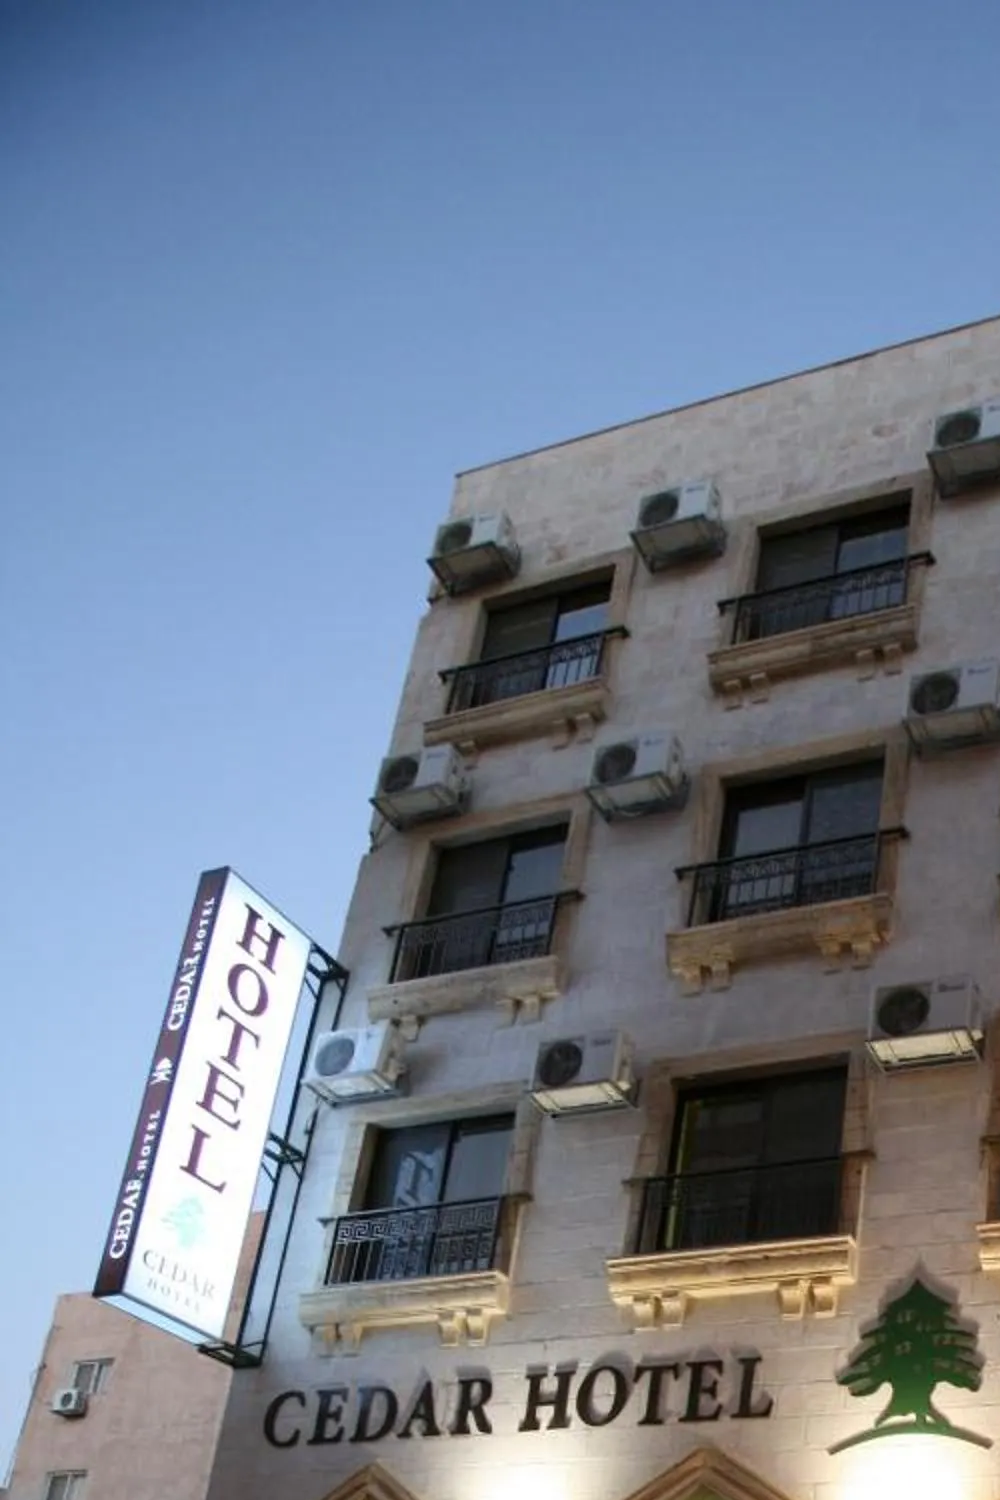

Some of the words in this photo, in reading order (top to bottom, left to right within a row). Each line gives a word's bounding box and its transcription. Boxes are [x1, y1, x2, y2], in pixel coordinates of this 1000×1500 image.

[167, 953, 201, 1032] CEDAR
[179, 902, 286, 1194] HOTEL
[136, 1109, 161, 1172] HOTEL
[142, 1248, 217, 1301] CEDAR
[146, 1277, 202, 1314] HOTEL
[263, 1374, 494, 1449] CEDAR
[517, 1354, 775, 1433] HOTEL
